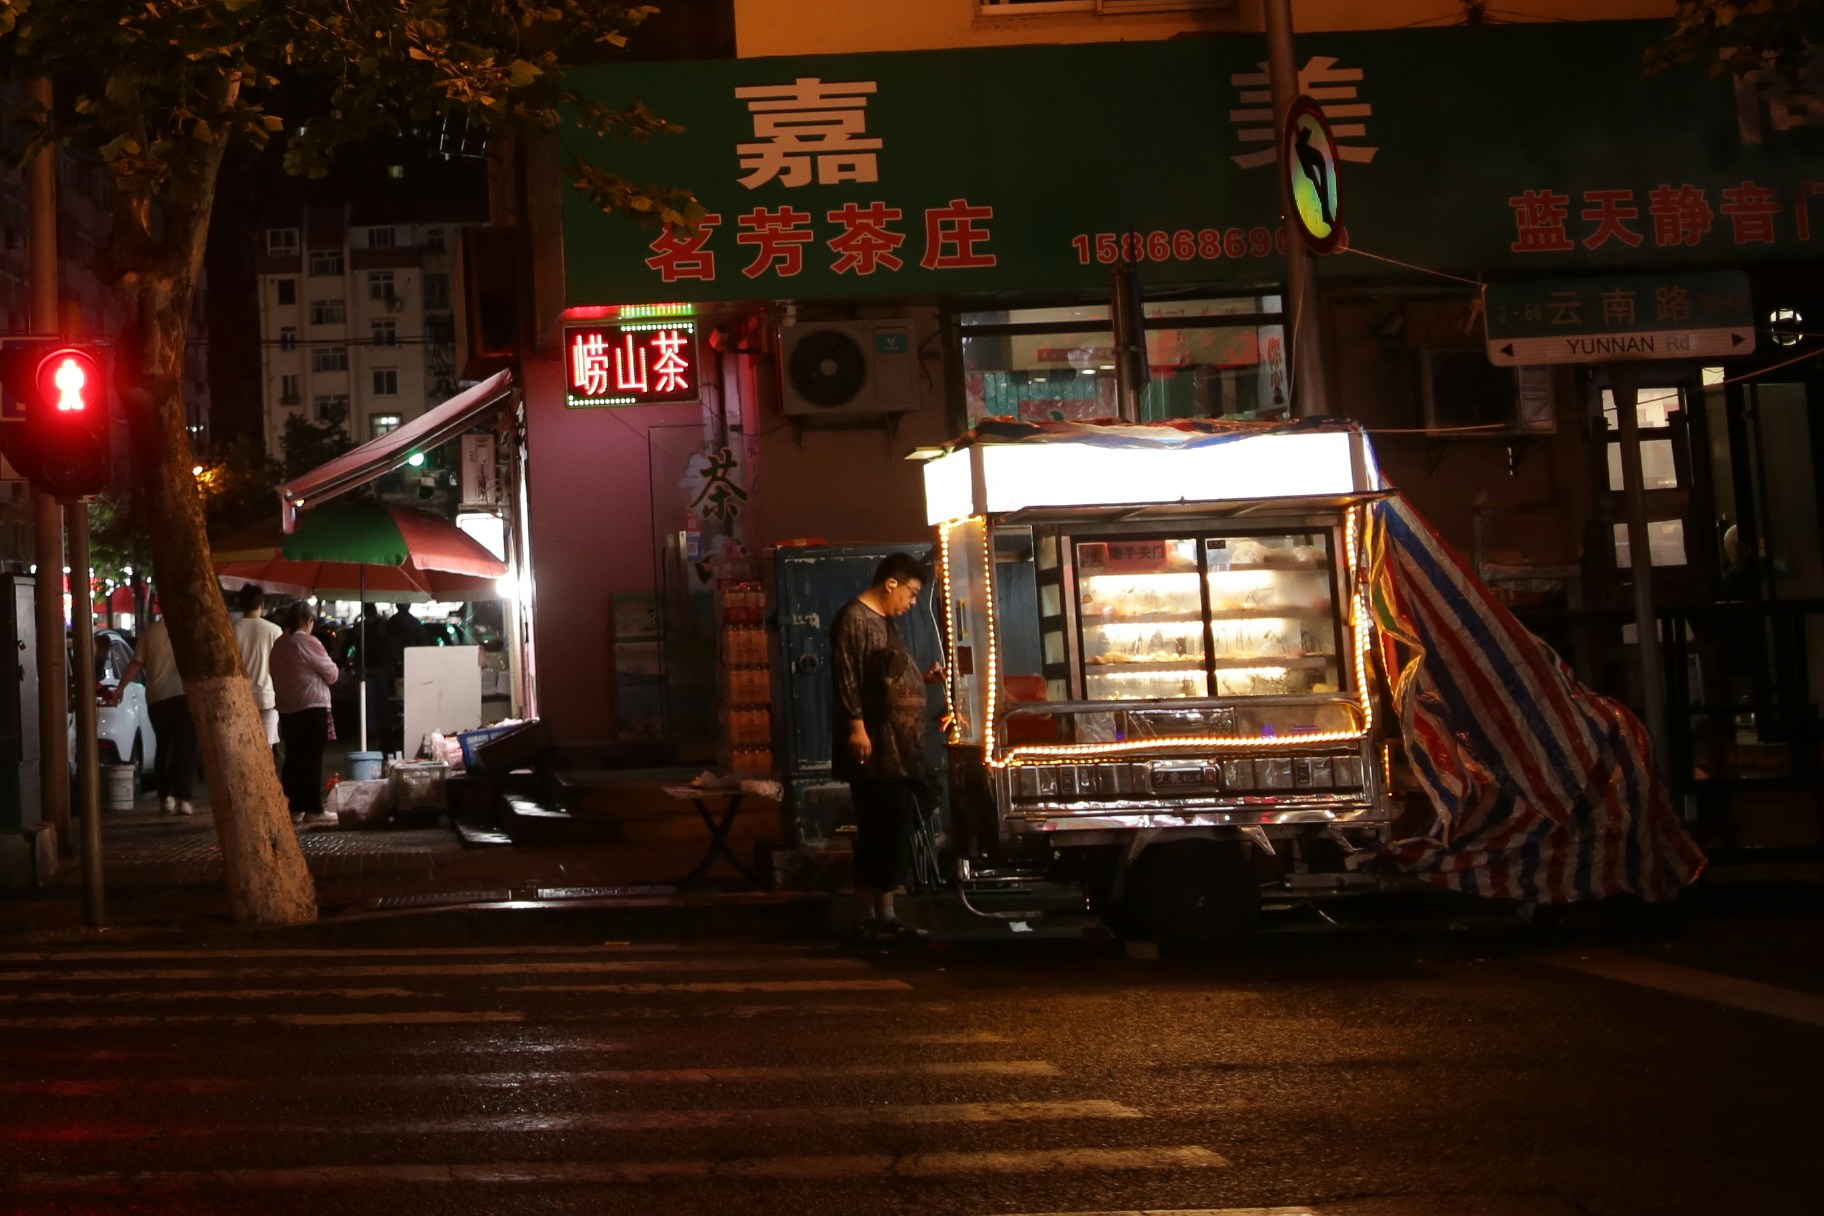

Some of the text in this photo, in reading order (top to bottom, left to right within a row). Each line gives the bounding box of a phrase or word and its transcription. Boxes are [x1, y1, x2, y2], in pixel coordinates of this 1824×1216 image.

[734, 76, 884, 191] 嘉
[1229, 55, 1380, 170] 美
[644, 197, 999, 284] 茗芳茶庄
[1071, 224, 1350, 265] 15866869
[1546, 285, 1692, 327] 云南路
[571, 330, 691, 396] 崂山茶
[1566, 335, 1655, 355] YUNNAN
